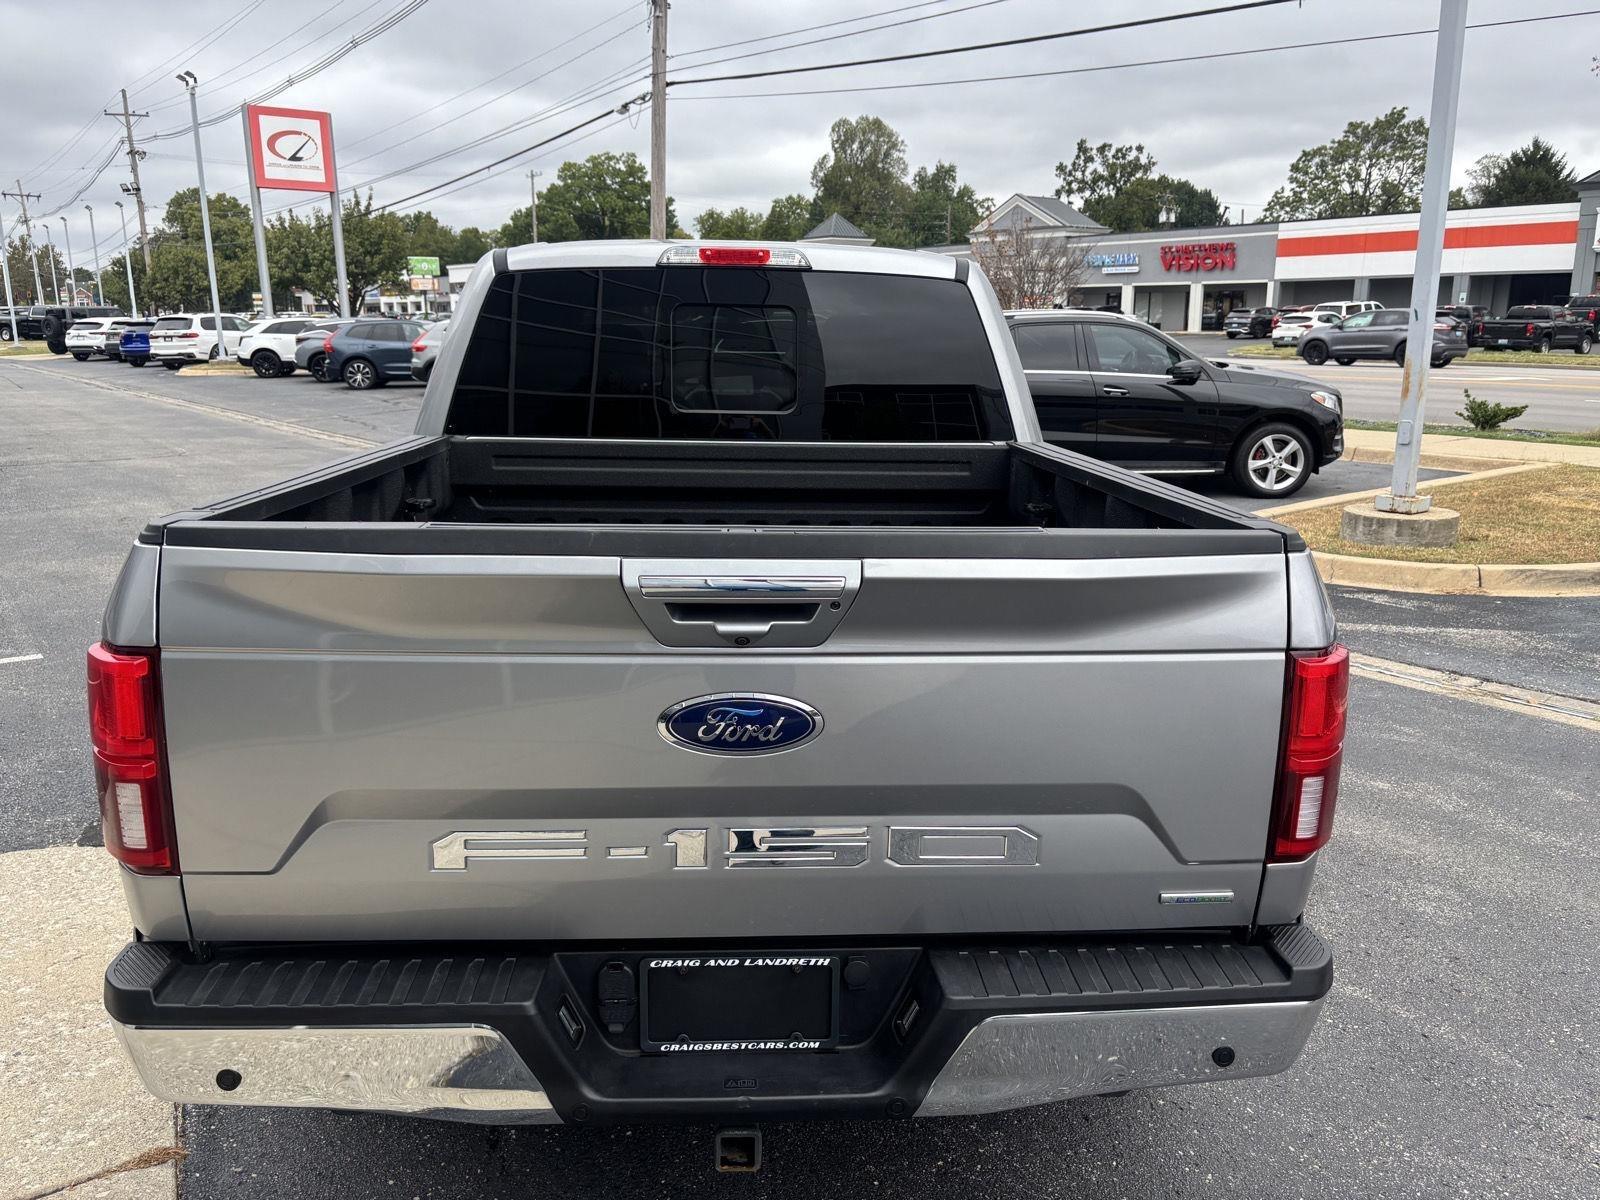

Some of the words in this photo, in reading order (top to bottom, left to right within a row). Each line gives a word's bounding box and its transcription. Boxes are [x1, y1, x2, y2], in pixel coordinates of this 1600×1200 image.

[1160, 252, 1236, 272] VISION
[697, 707, 786, 742] Ford
[429, 825, 1041, 872] F-150
[650, 959, 700, 968] CRAIG
[704, 959, 739, 967] AND
[744, 958, 831, 967] LANDRETH
[660, 1041, 820, 1051] CRAIGSBESTCARS.COM
